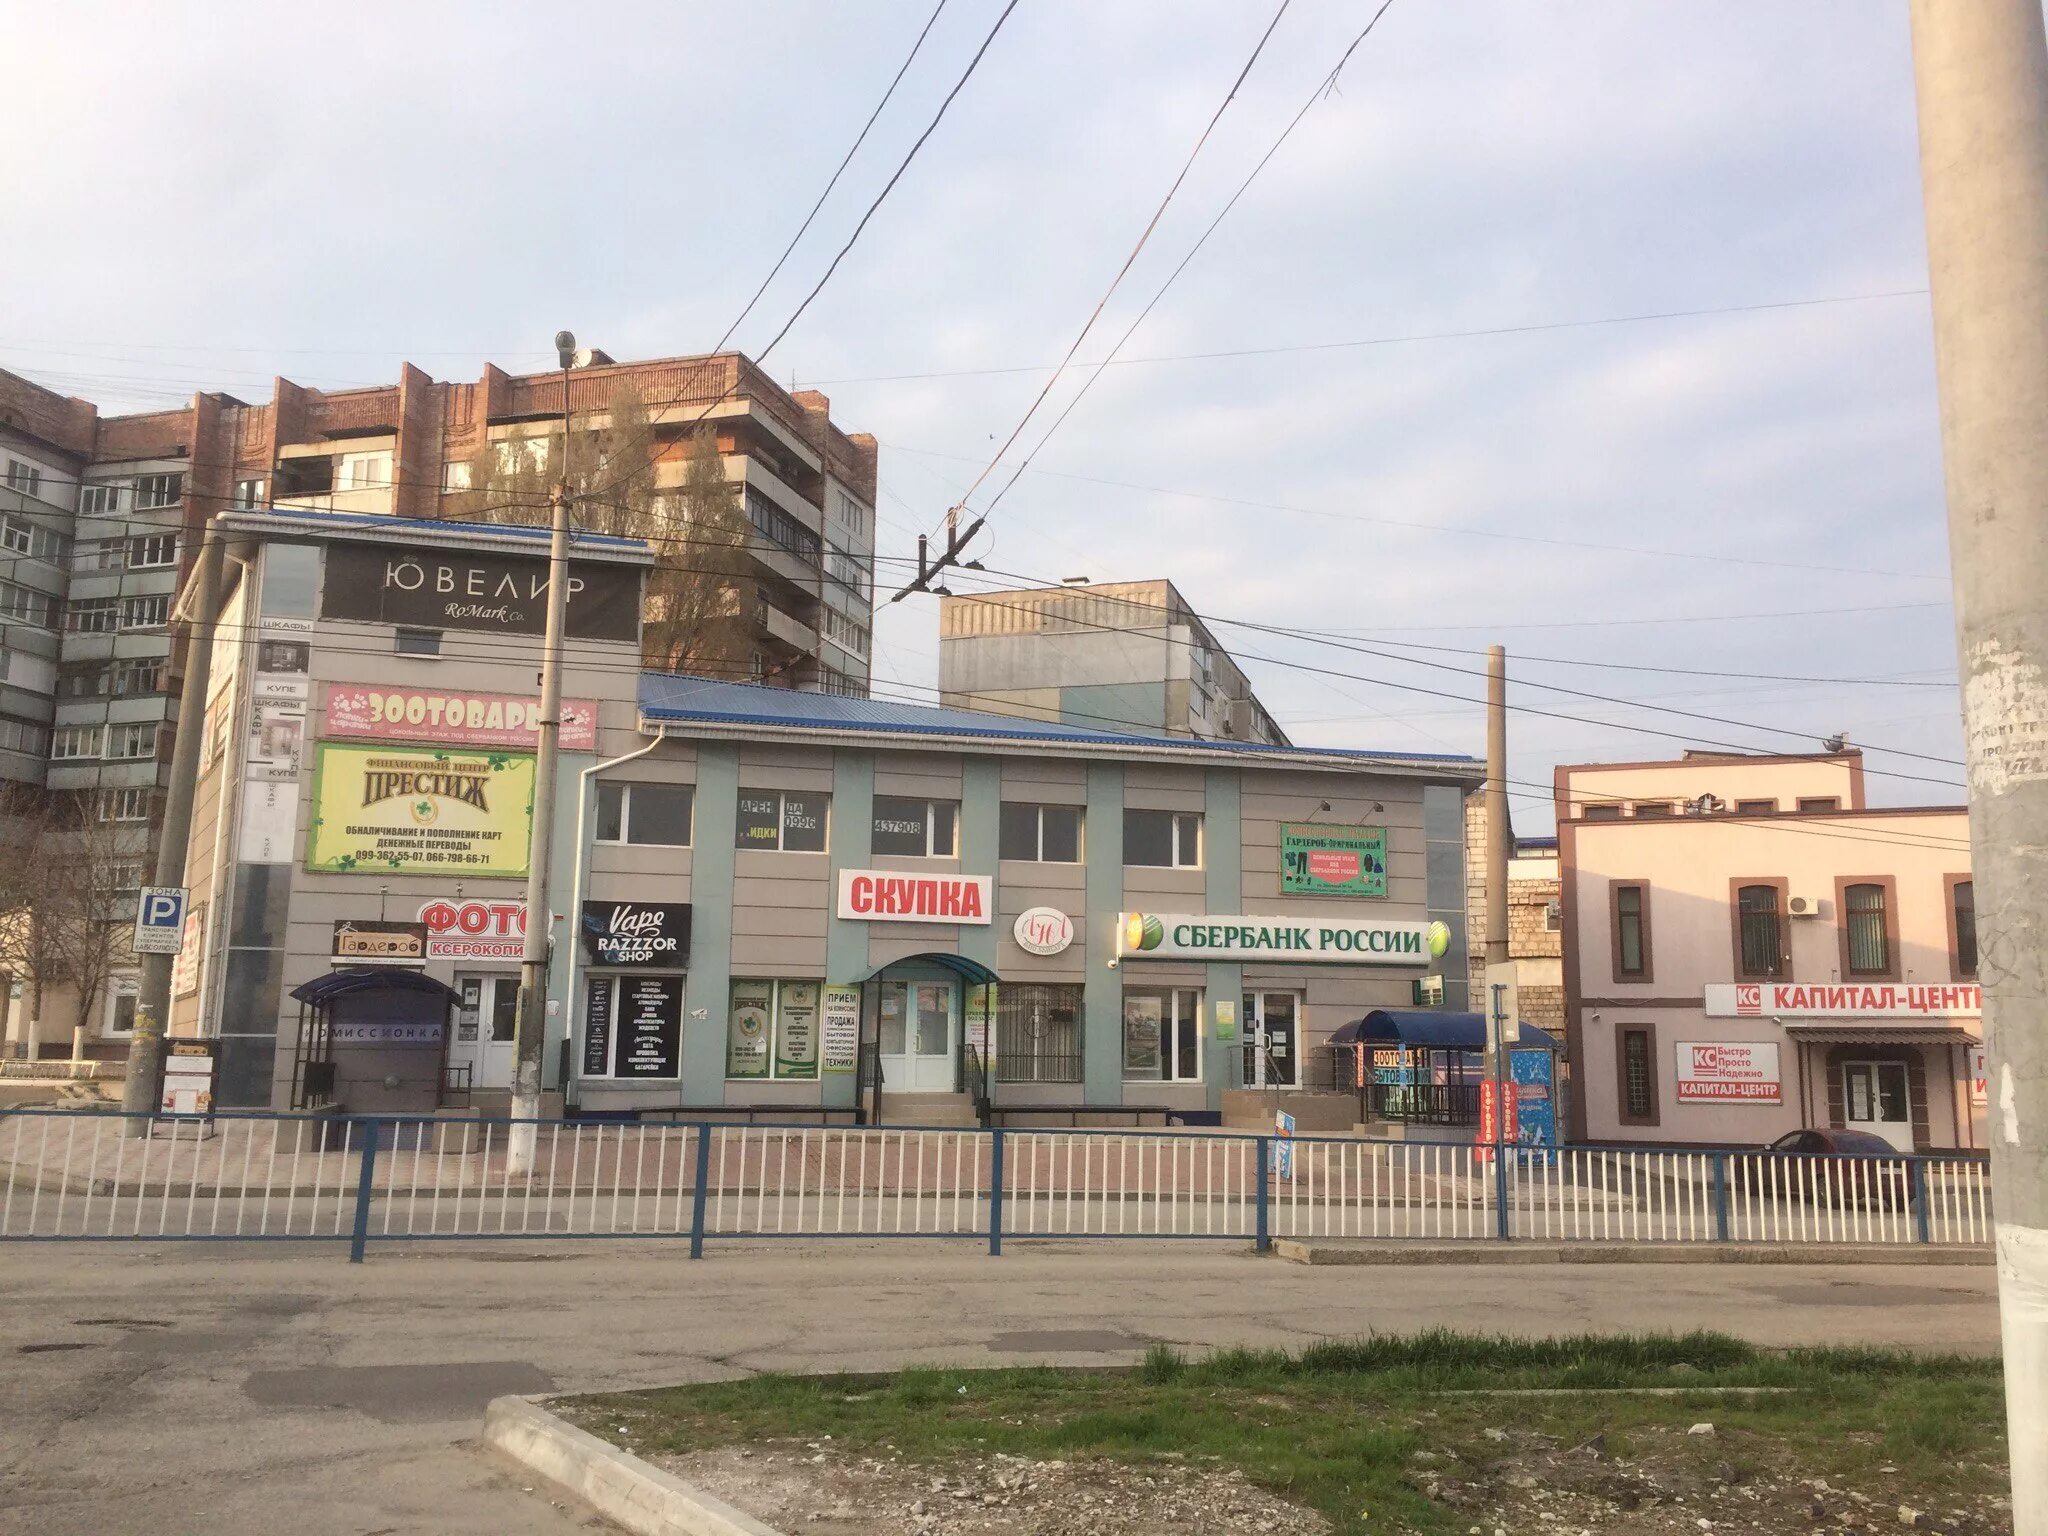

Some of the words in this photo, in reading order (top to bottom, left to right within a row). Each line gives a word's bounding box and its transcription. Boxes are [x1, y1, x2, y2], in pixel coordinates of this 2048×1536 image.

[386, 561, 585, 603] ЮВЕЛИР
[444, 602, 509, 623] RoMark
[263, 620, 311, 630] ШКАФЫ
[266, 685, 297, 693] КУПЕ
[253, 700, 301, 709] ШКАФЫ
[366, 758, 450, 771] ФИНАНСОВЫЙ
[452, 762, 491, 773] ЦЕНТР
[268, 769, 298, 777] КУПЕ
[361, 770, 491, 815] ПРЕСТИЖ
[741, 801, 774, 813] АРЕН
[784, 816, 816, 828] 0996
[875, 819, 921, 834] 437908
[345, 825, 419, 838] ОБНАЛИЧИВАНИЕ
[419, 829, 426, 837] И
[427, 829, 481, 840] ПОПОЛНЕНИЕ
[481, 831, 502, 841] КАРТ
[376, 838, 424, 850] ДЕНЕЖНЫЕ
[425, 840, 471, 851] ПЕРЕВОДЫ
[148, 887, 182, 896] ЗОНА
[851, 876, 983, 918] СКУПКА
[609, 905, 665, 936] Vape
[342, 935, 419, 951] Гардероб
[597, 938, 677, 951] RAZZZOR
[1174, 924, 1313, 951] СБЕРБАНК
[1319, 929, 1421, 953] РОССИИ
[432, 942, 524, 957] КСЕРОКОПИ
[618, 951, 654, 962] SHOP
[828, 993, 857, 1003] ПРИЕМ
[1717, 1046, 1752, 1058] Быстро
[825, 1058, 854, 1067] ТЕХНИКИ
[1717, 1057, 1752, 1069] Просто
[1717, 1068, 1764, 1079] Надежно
[1680, 1082, 1779, 1096] КАПИТАЛ-ЦЕНТР
